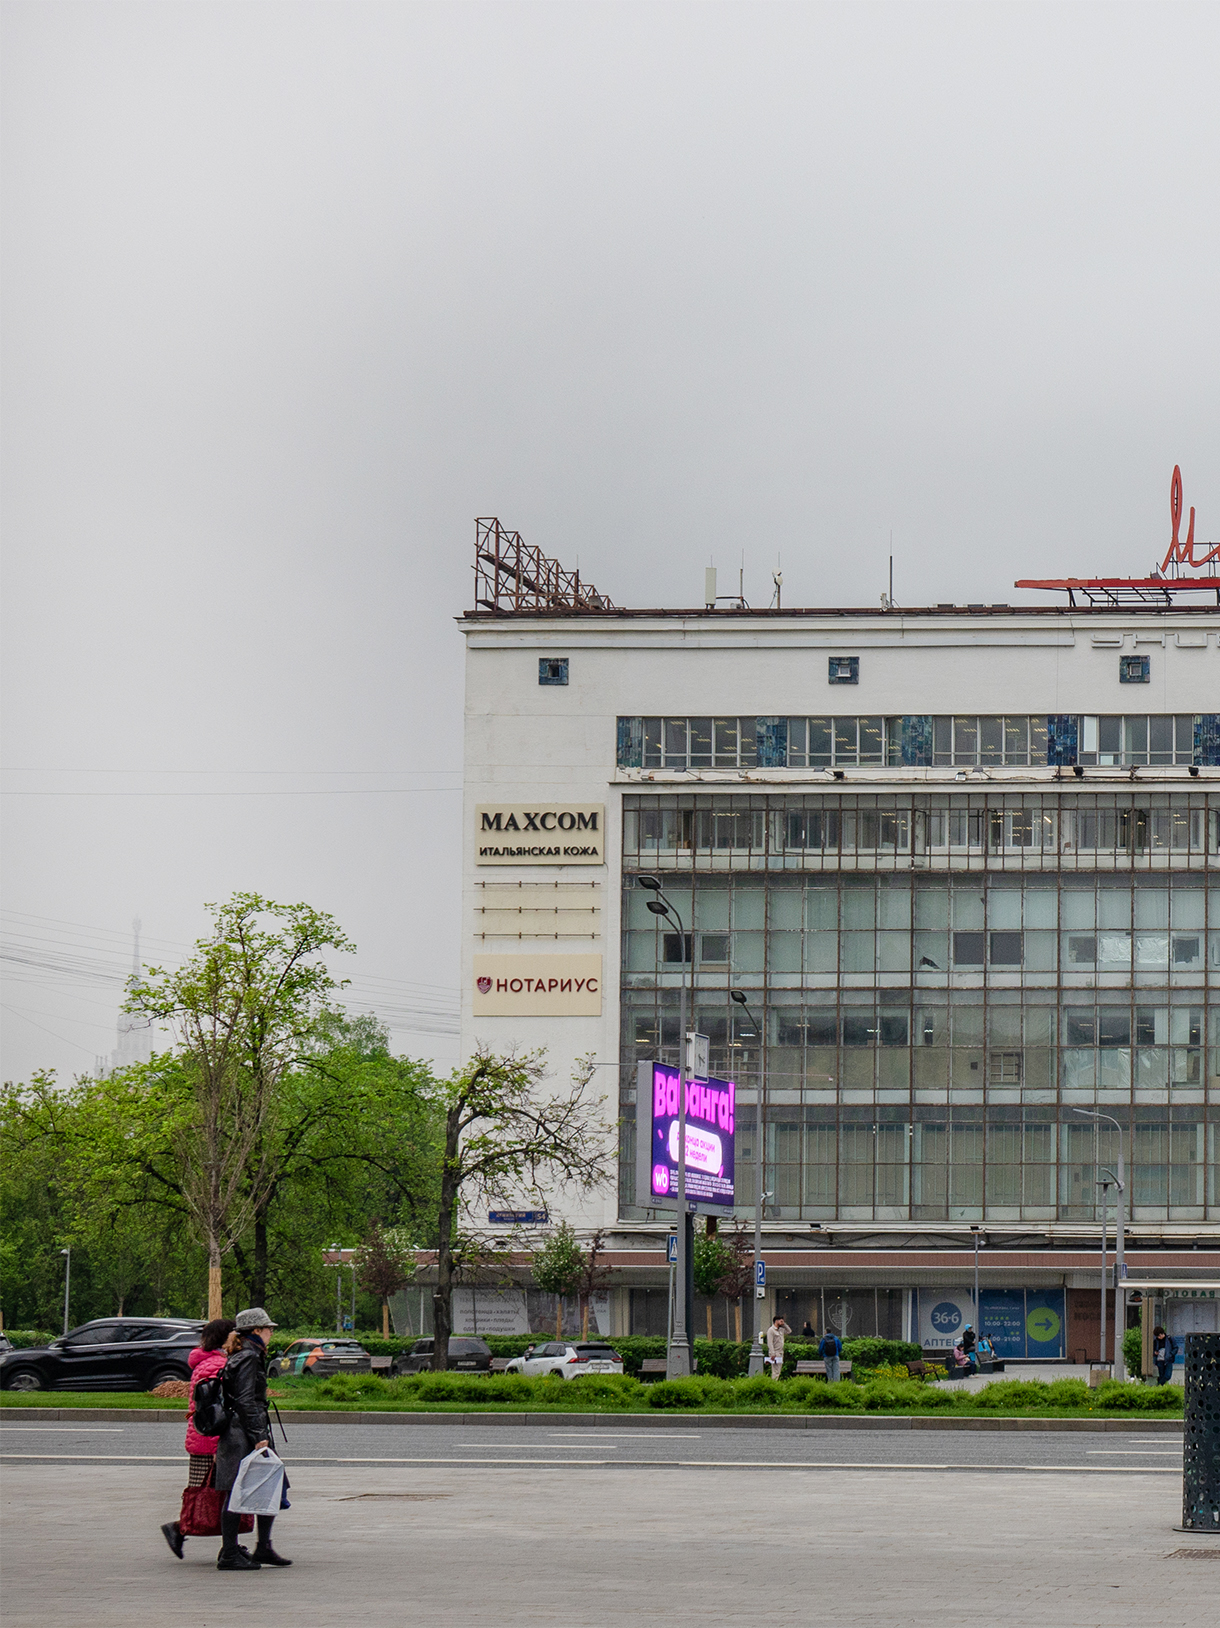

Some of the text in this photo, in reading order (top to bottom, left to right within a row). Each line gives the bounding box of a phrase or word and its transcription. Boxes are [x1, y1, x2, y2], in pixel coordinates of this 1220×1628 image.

[480, 811, 598, 831] MAXCOM
[479, 846, 598, 856] ИТАЛЬЯНСКАЯ КОЖА
[496, 978, 598, 993] НОТАРИУС
[655, 1168, 668, 1188] wb
